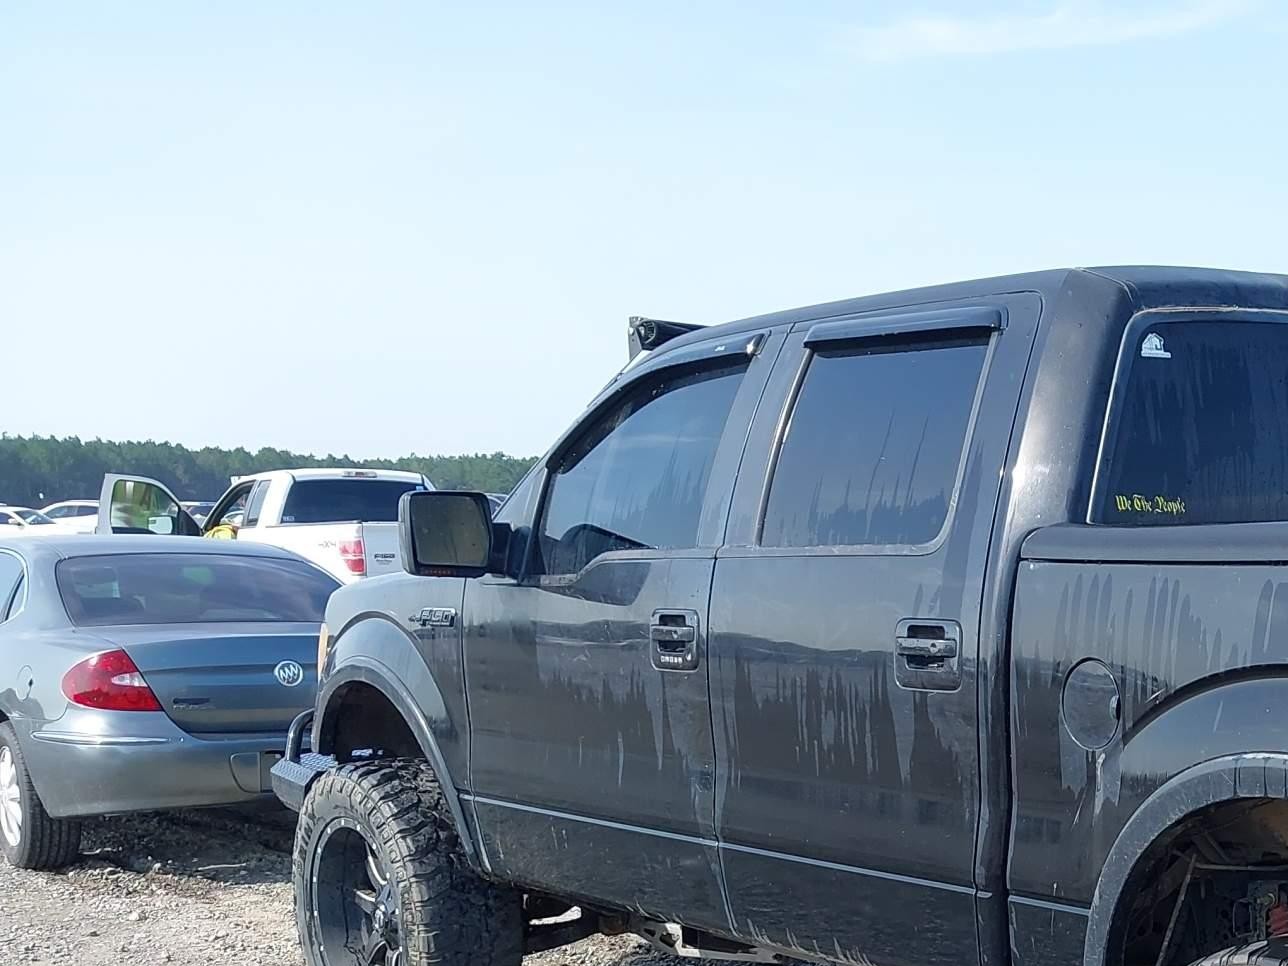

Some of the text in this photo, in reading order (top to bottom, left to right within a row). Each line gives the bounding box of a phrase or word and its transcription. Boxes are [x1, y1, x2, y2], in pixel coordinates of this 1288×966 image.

[1115, 494, 1186, 515] We The People
